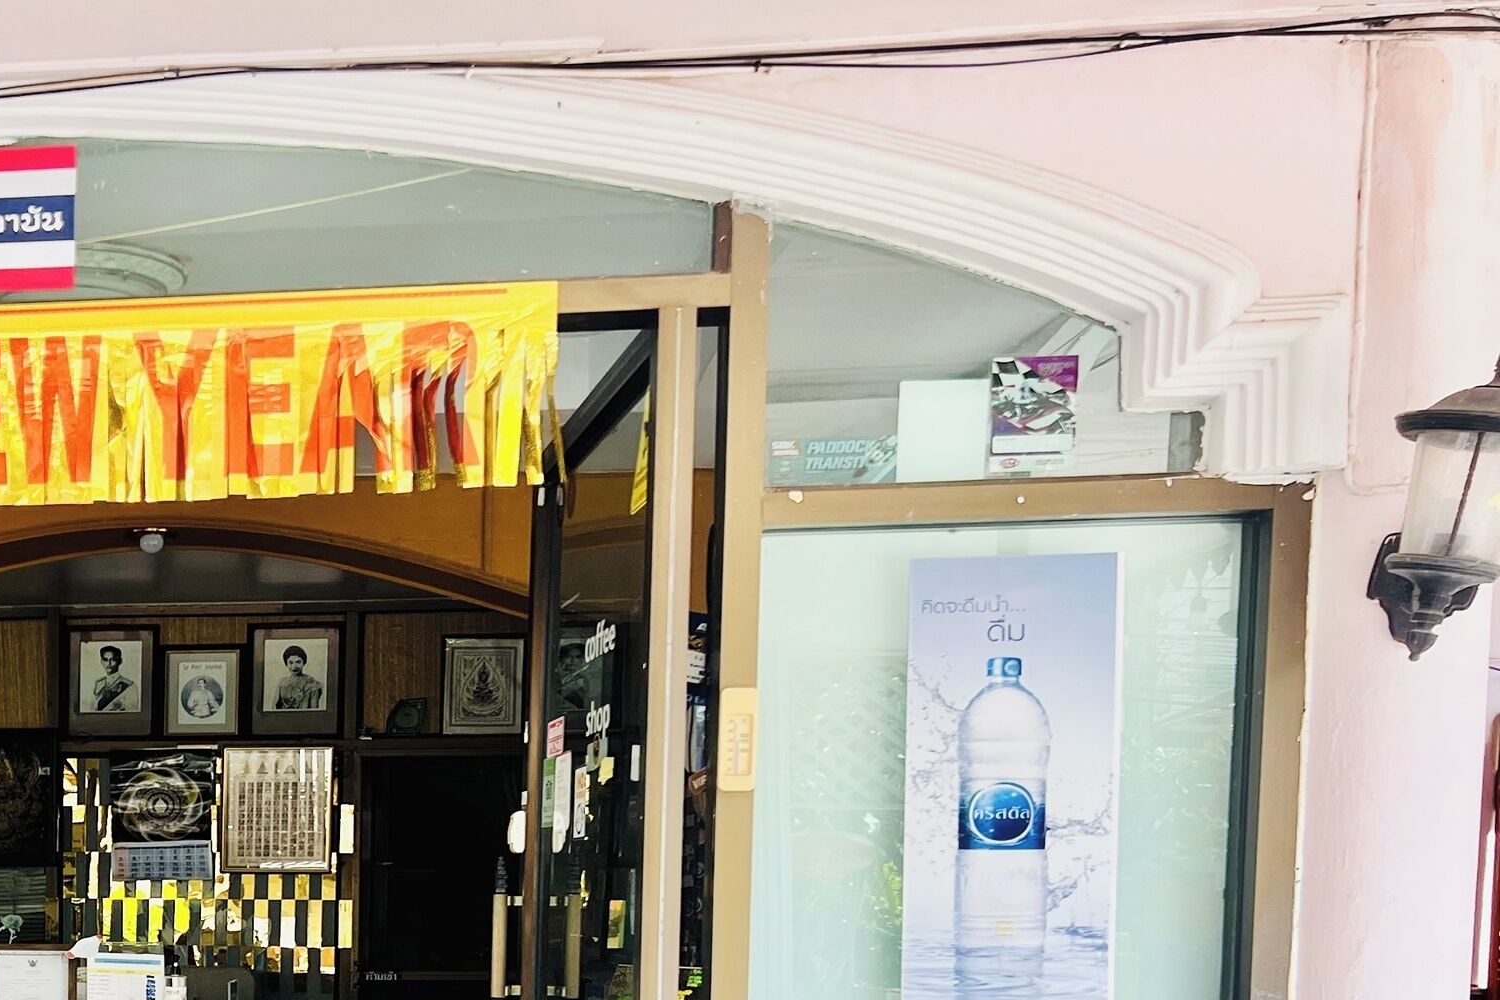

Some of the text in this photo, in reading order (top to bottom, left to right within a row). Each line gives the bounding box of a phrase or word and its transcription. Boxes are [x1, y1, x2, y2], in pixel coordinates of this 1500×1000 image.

[585, 618, 617, 663] coffee
[987, 613, 1025, 642] ดื่ม
[585, 700, 610, 741] shop
[973, 805, 1030, 821] คริสตัล
